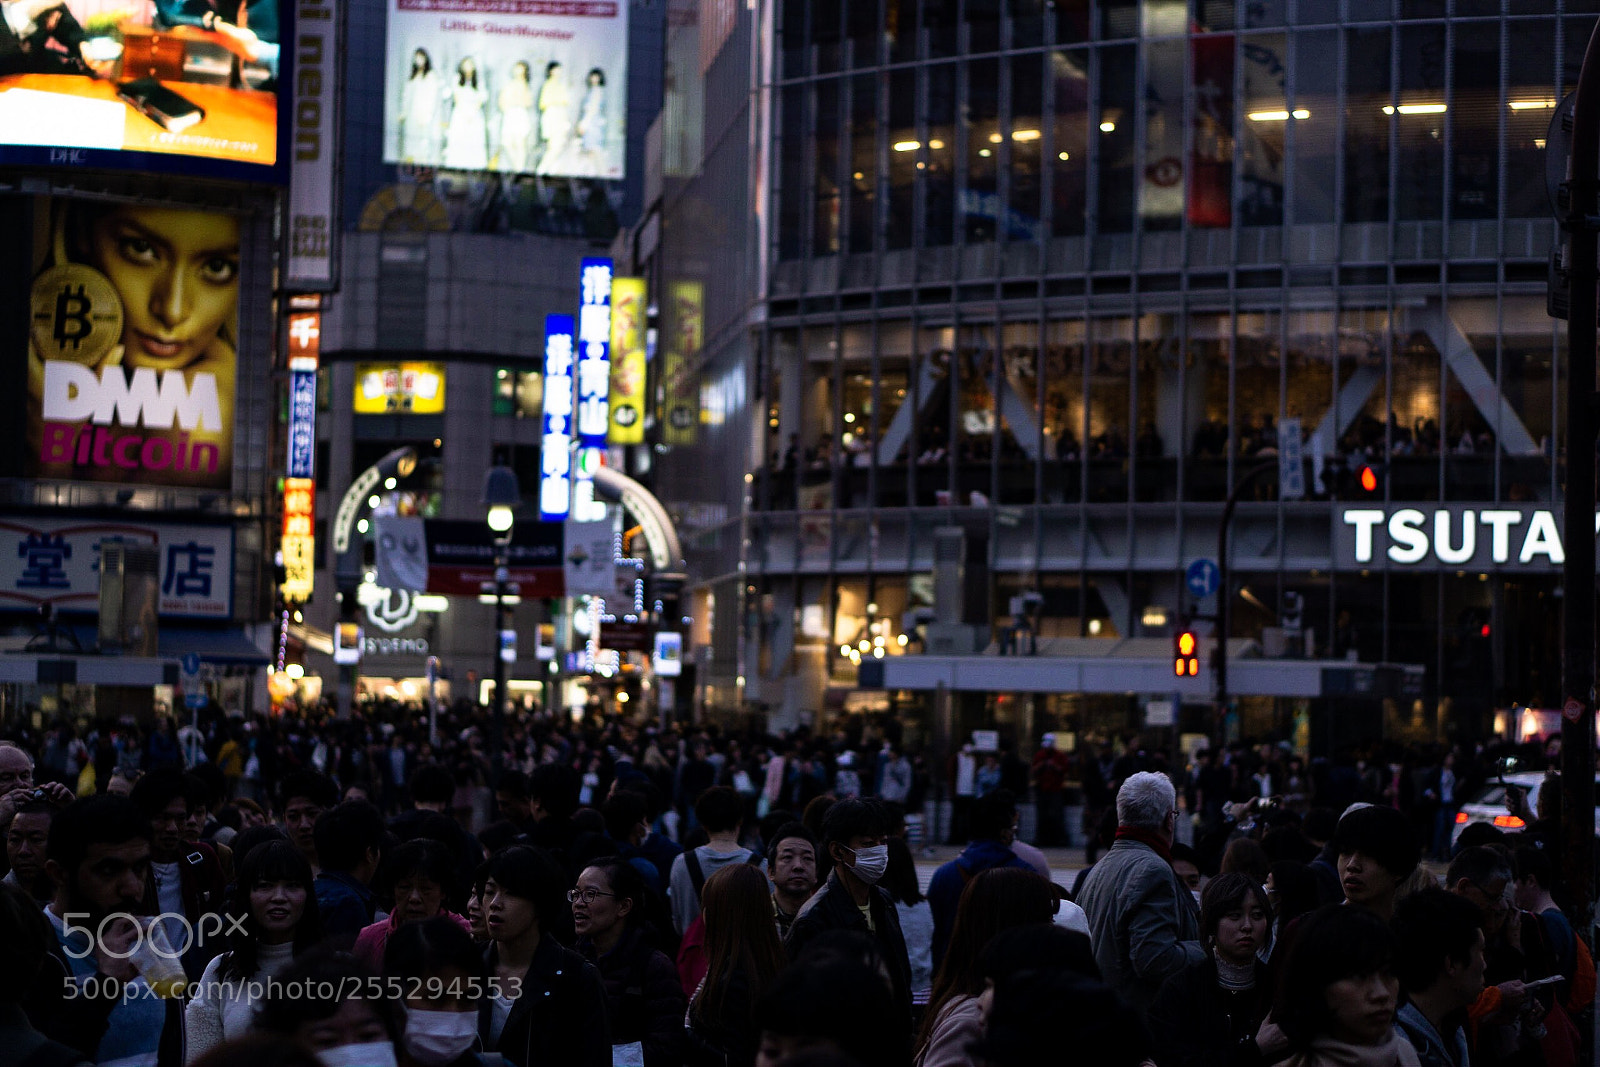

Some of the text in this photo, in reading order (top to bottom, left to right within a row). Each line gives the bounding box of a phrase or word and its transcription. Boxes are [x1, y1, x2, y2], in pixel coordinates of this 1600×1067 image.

[297, 35, 323, 161] neon
[43, 359, 222, 433] DMM
[40, 422, 219, 474] Bitcoin
[16, 532, 215, 597] 堂店
[1344, 508, 1600, 565] TSUTA
